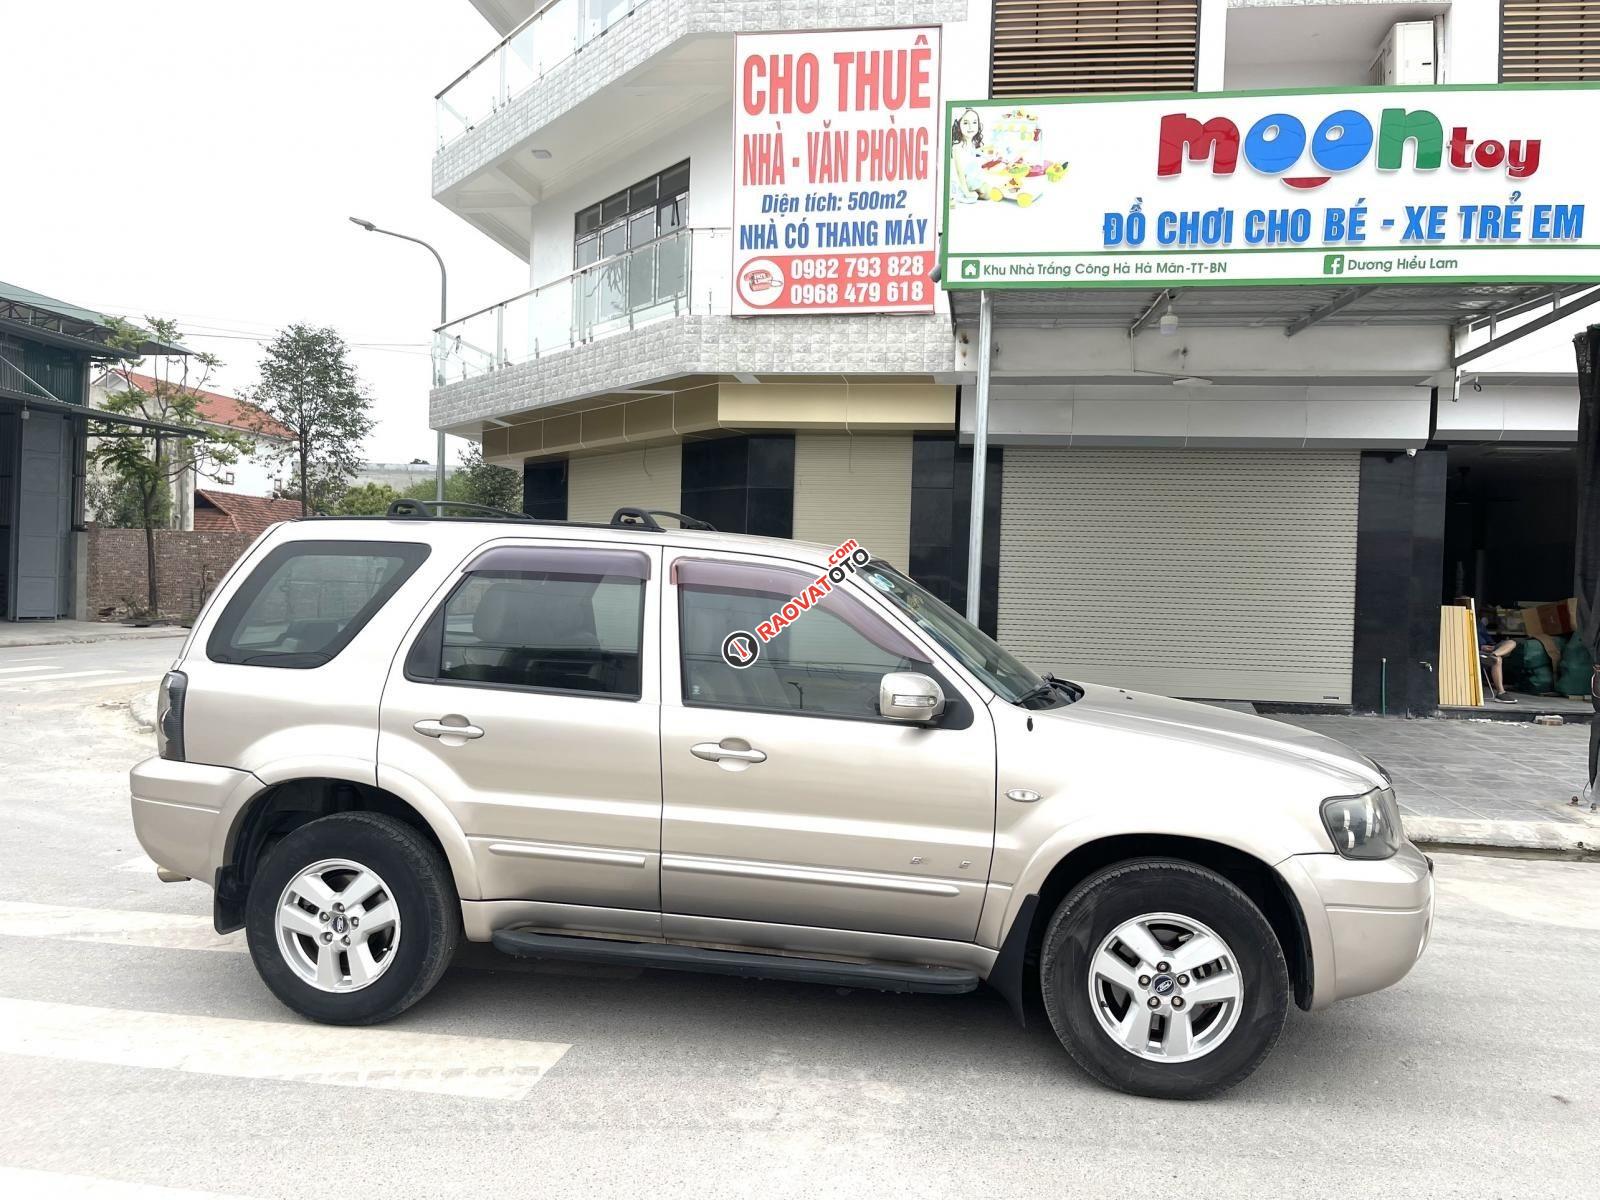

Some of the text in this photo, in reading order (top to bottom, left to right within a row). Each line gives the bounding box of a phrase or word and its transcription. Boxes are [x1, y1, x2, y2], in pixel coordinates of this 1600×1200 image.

[743, 34, 931, 115] CHO THUÊ
[743, 115, 929, 185] NHÀ - VĂN PHÒNG
[1157, 108, 1541, 179] moon toy
[762, 190, 908, 217] Diện tích: 500m2
[1102, 196, 1146, 246] ĐỒ
[1157, 207, 1234, 245] CHƠI
[1245, 208, 1311, 243] CHO
[1323, 197, 1368, 242] BÉ
[1402, 205, 1448, 240] XE
[1459, 190, 1523, 239] TRẺ
[1531, 204, 1585, 239] EM
[740, 214, 928, 250] NHÀ CÓ THANG MÁY
[791, 259, 839, 279] 0982
[845, 257, 882, 278] 793
[887, 255, 924, 276] 828
[983, 264, 1006, 275] Khu
[1009, 263, 1035, 275] Nhà
[1037, 261, 1071, 277] Trắng
[1075, 263, 1110, 277] Công
[1113, 261, 1131, 274] Hà
[1135, 261, 1153, 274] Hà
[1429, 258, 1458, 269] Lam
[790, 280, 924, 304] 0968 479 618
